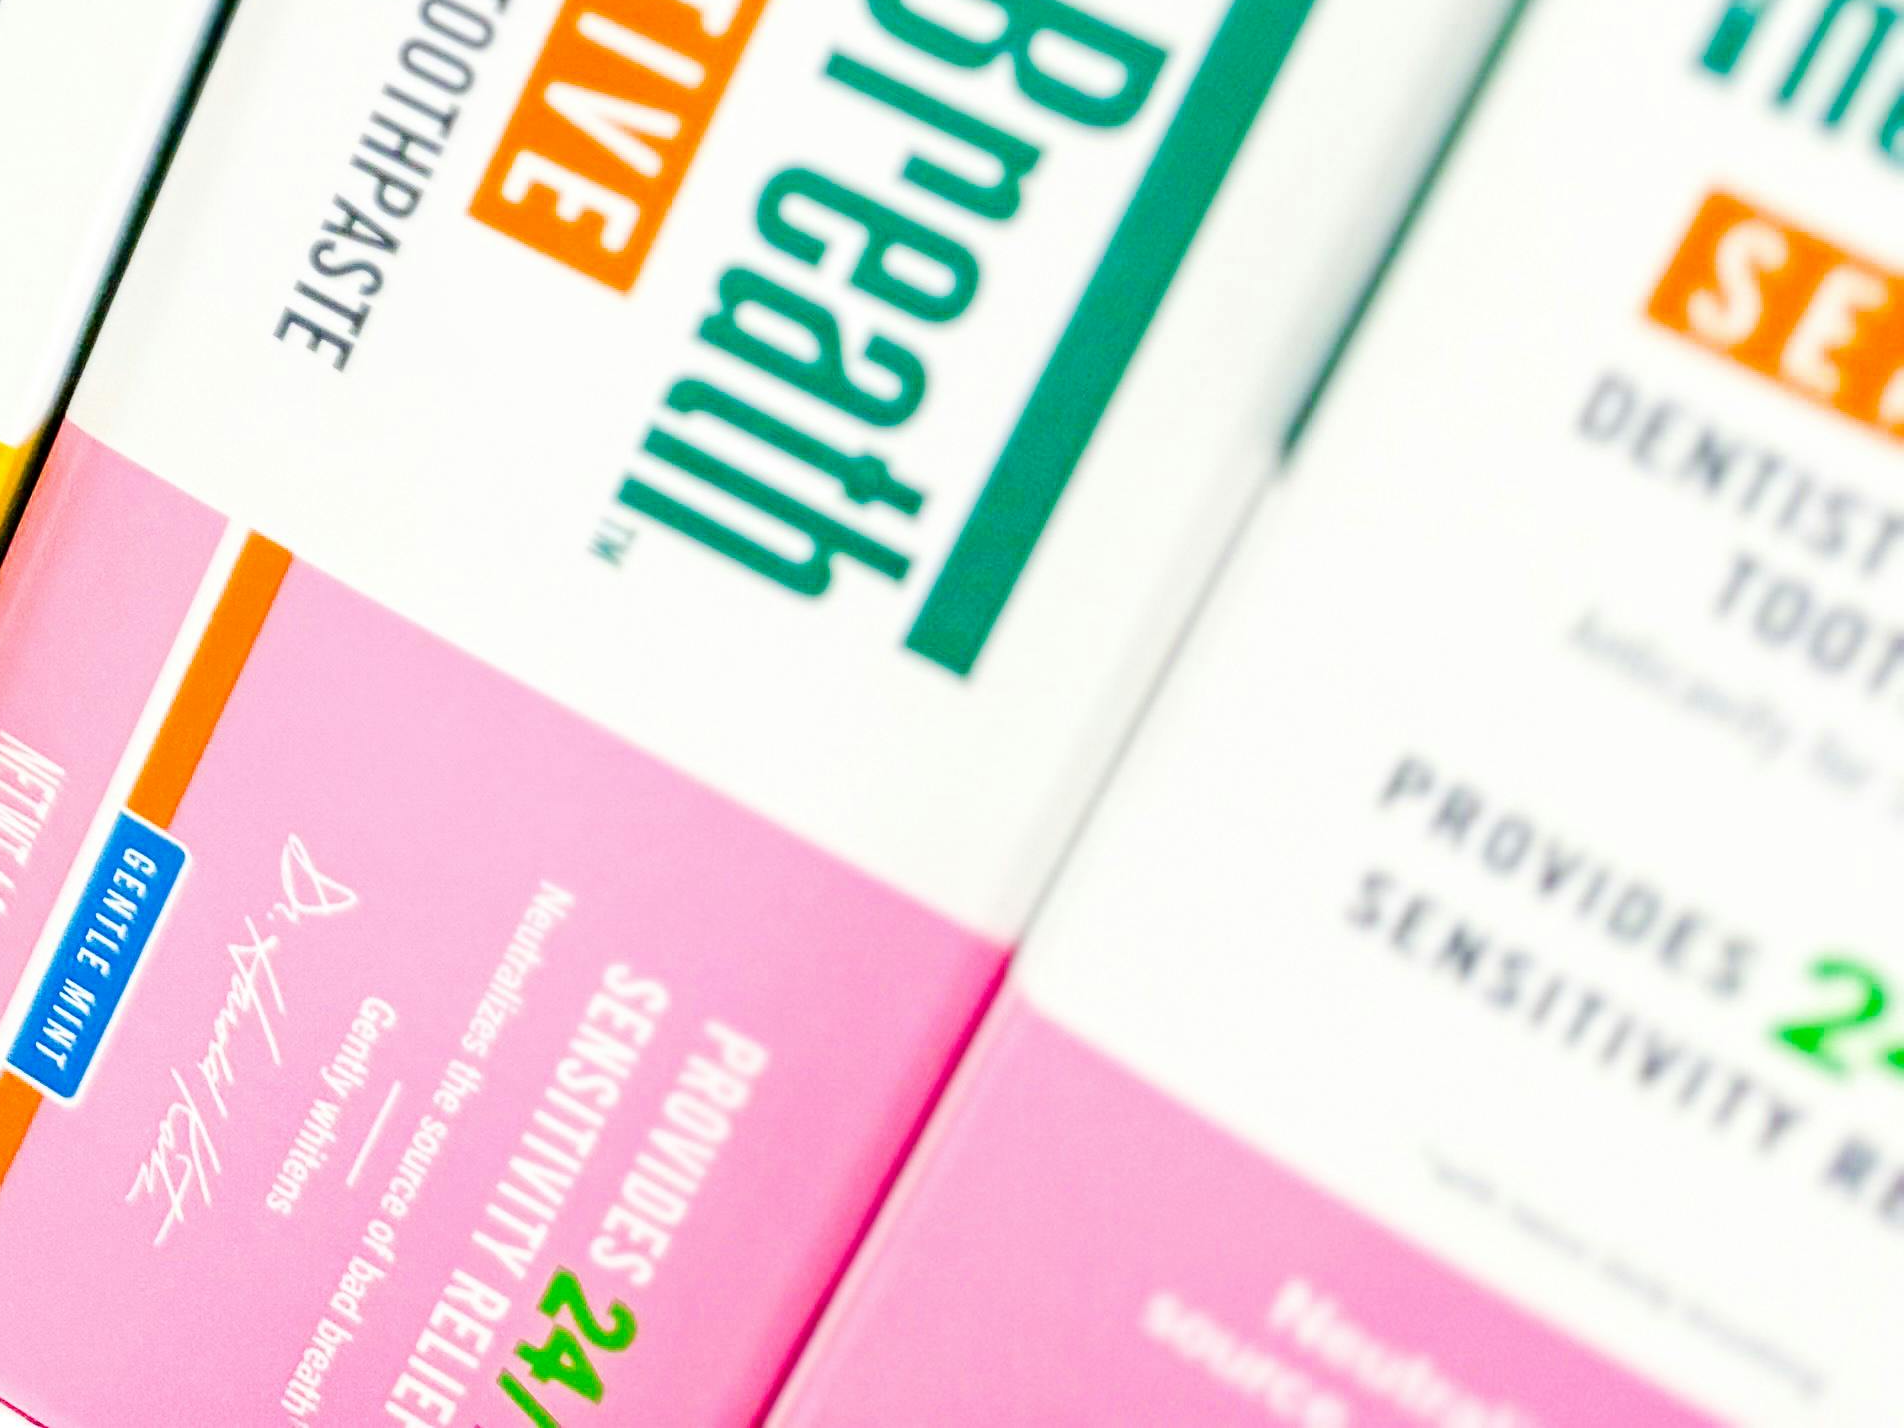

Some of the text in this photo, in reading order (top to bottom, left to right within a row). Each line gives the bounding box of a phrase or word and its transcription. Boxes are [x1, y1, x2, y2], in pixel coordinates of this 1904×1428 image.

[36, 847, 158, 1070] GENTLE MINT
[461, 879, 576, 1058] Neutralizes
[265, 995, 397, 1215] Gently whitens
[381, 1114, 448, 1219] source
[433, 1059, 483, 1115] the
[472, 963, 669, 1280] SENSITIVITY
[590, 1018, 769, 1287] PROVIDES
[330, 1254, 385, 1325] bad
[363, 1218, 397, 1266] of
